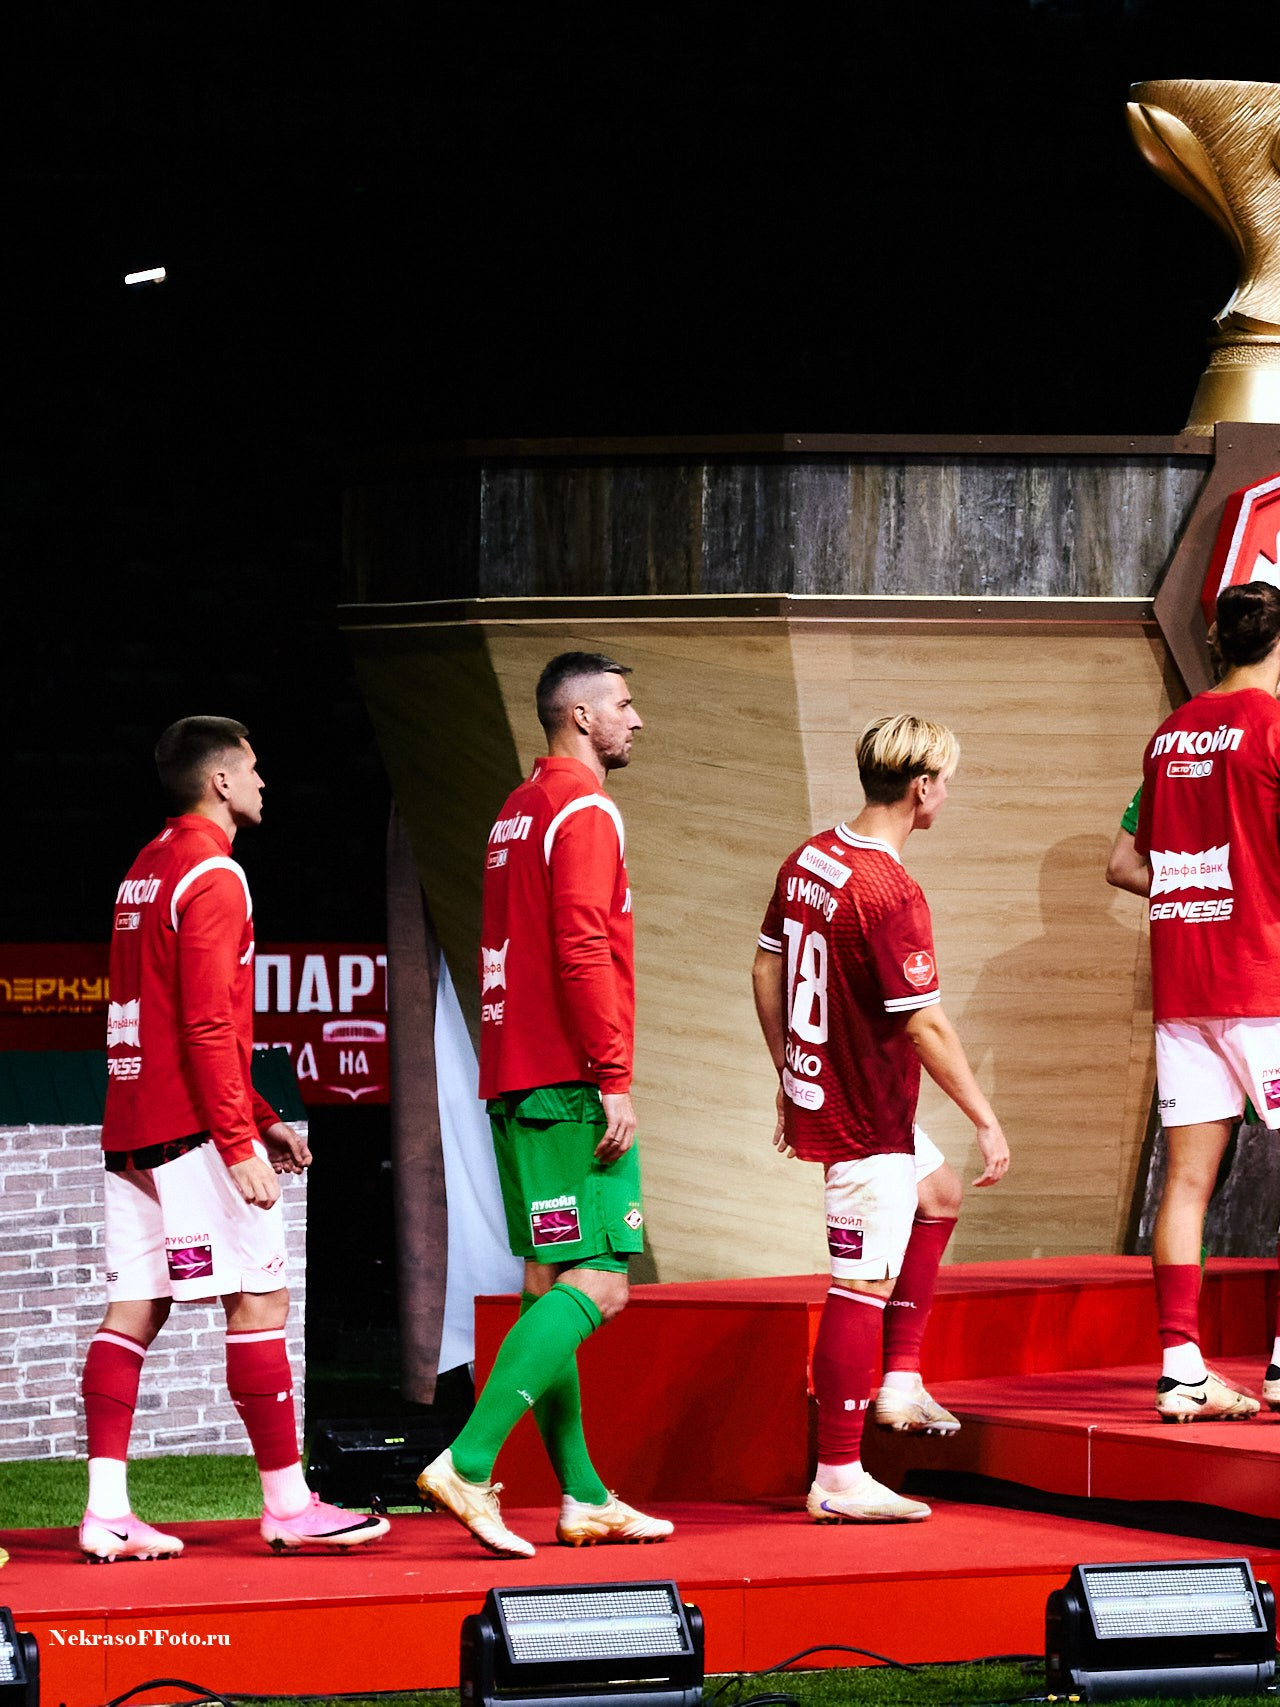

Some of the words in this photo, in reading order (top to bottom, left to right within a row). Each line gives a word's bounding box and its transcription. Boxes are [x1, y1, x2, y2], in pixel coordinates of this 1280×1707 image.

[1151, 725, 1244, 759] ЛУКОЙЛ
[1159, 862, 1198, 882] Альфа
[1200, 862, 1223, 874] Банк
[1149, 898, 1234, 921] GENESIS
[783, 917, 828, 1045] 18
[531, 1196, 577, 1212] ЛУКОЙЛ
